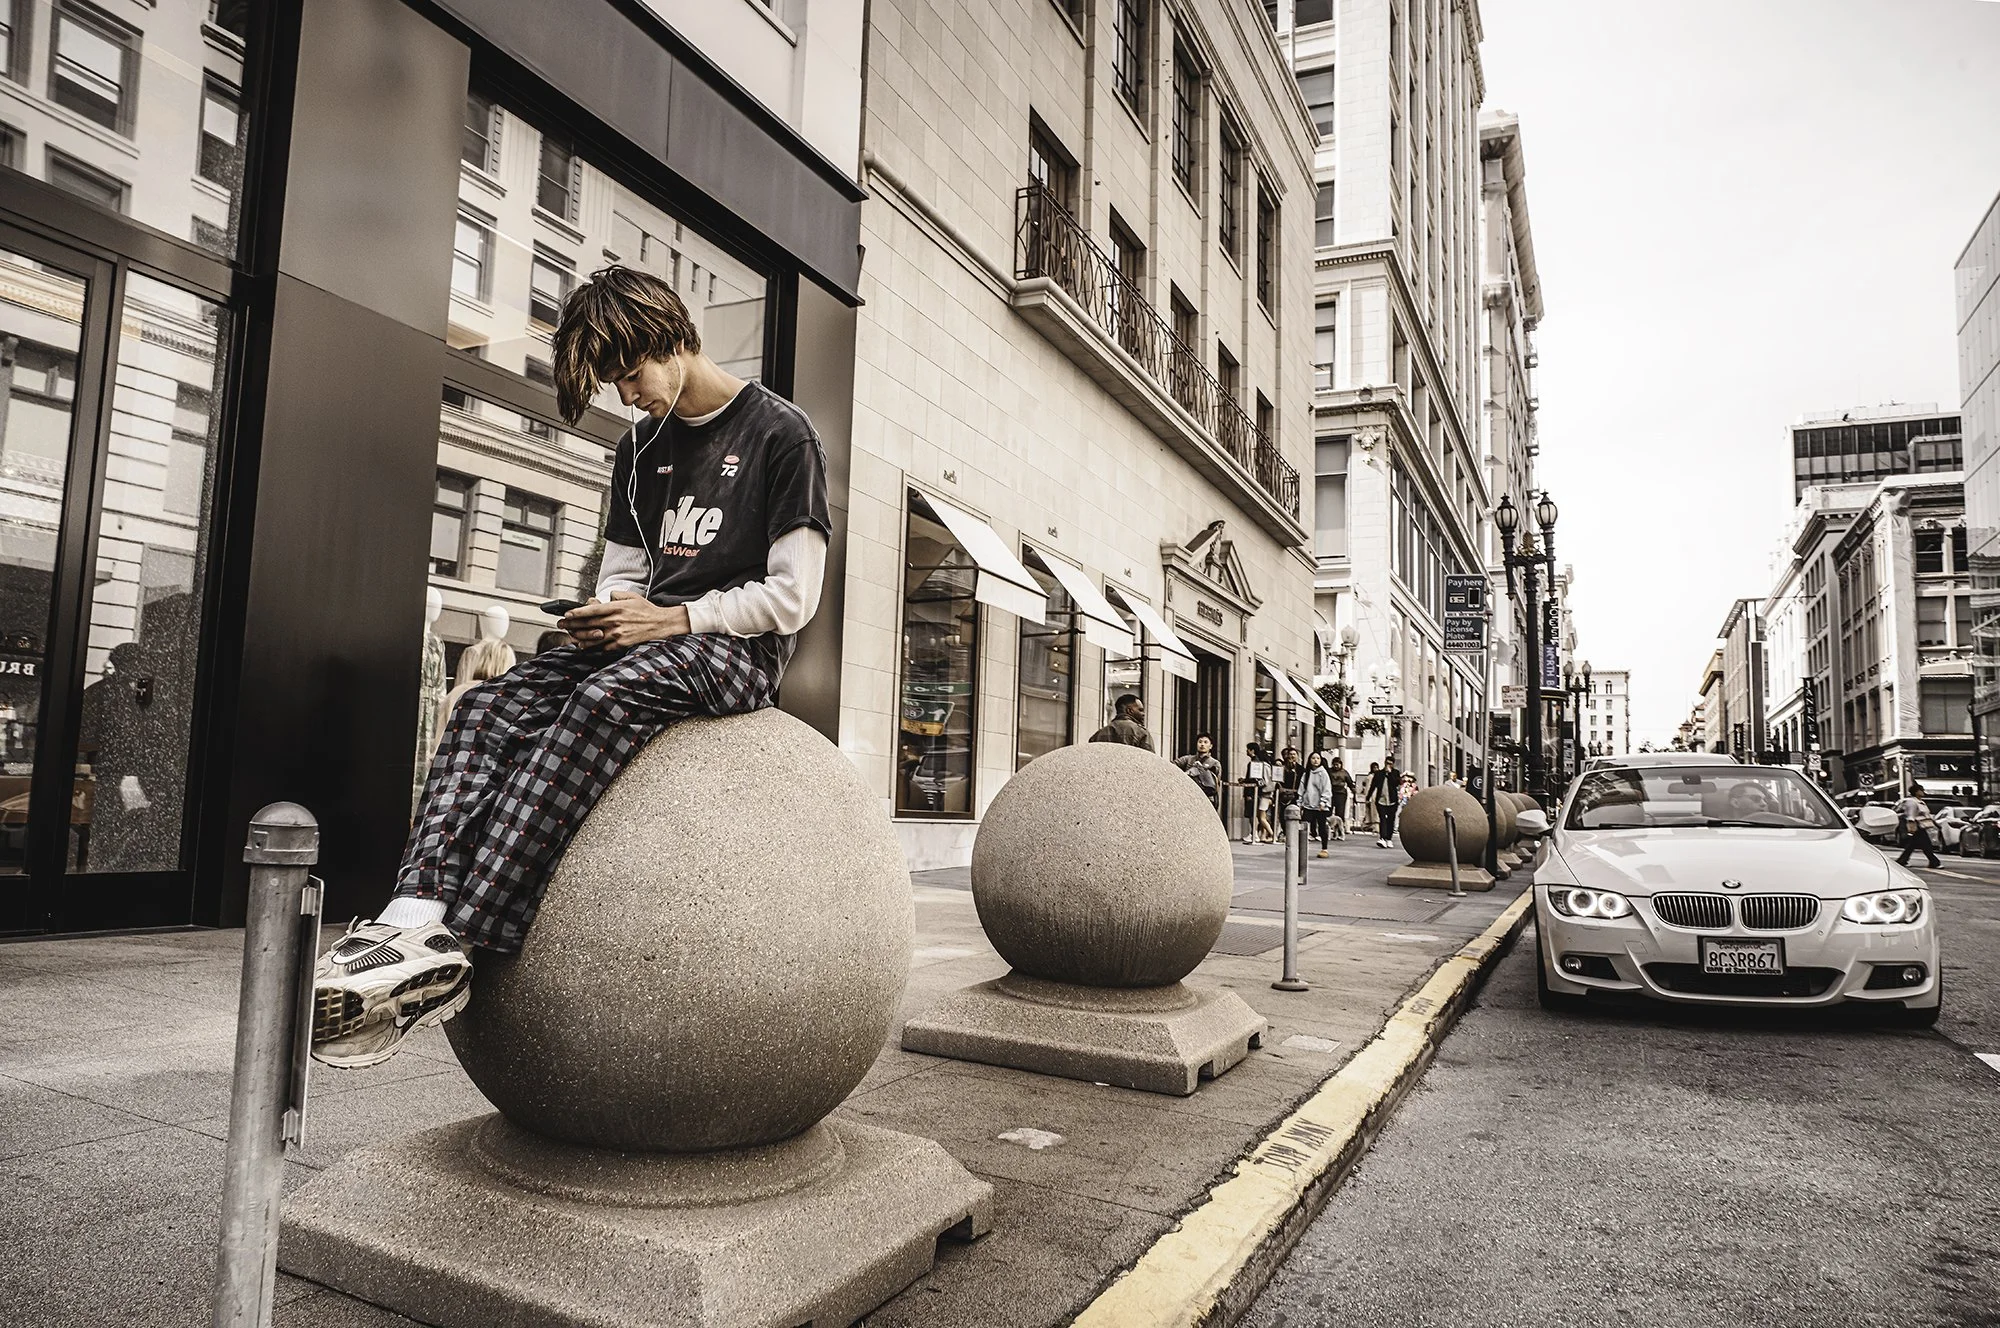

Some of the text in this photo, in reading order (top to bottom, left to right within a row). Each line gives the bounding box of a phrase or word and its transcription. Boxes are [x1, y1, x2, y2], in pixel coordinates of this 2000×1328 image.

[720, 464, 739, 477] 72
[1447, 578, 1483, 587] Pay here
[1446, 619, 1473, 628] Pay by
[1546, 647, 1556, 677] NORTH
[1709, 951, 1776, 968] 8CSR867
